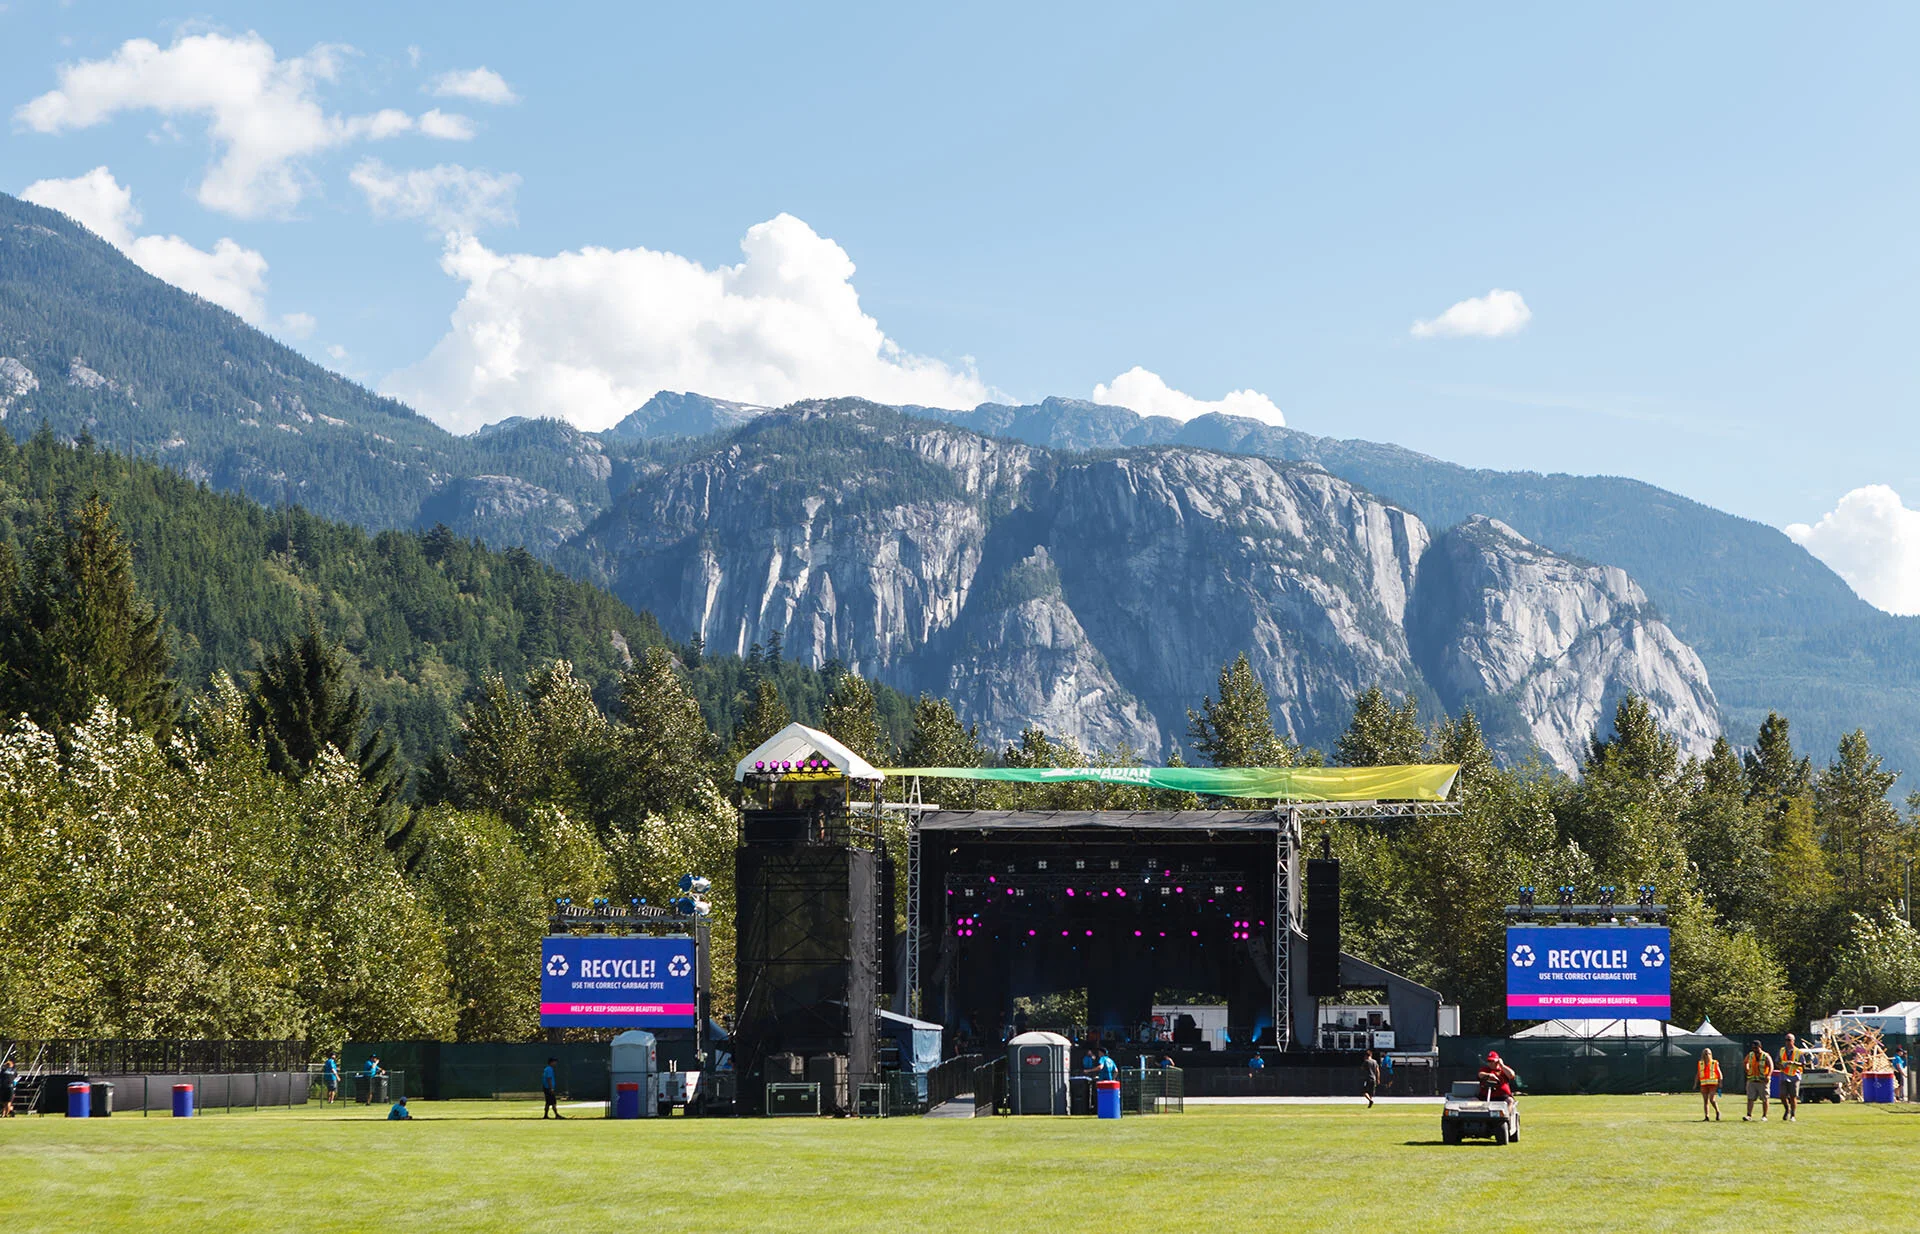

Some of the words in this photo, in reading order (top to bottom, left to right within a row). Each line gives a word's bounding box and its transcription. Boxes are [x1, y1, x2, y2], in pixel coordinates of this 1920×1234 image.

[1071, 767, 1151, 778] CANADIAN
[1548, 949, 1628, 969] RECYCLE!
[581, 959, 656, 978] RECYCLE!
[1539, 972, 1551, 980] USE
[1552, 972, 1564, 980] THE
[1564, 972, 1592, 980] CORRECT
[1592, 972, 1621, 980] GARBAGE
[1622, 972, 1637, 980] TOTE
[571, 981, 583, 989] USE
[584, 981, 595, 989] THE
[595, 981, 621, 989] CORRECT
[621, 981, 649, 989] GARBAGE
[650, 981, 664, 989] TOTE
